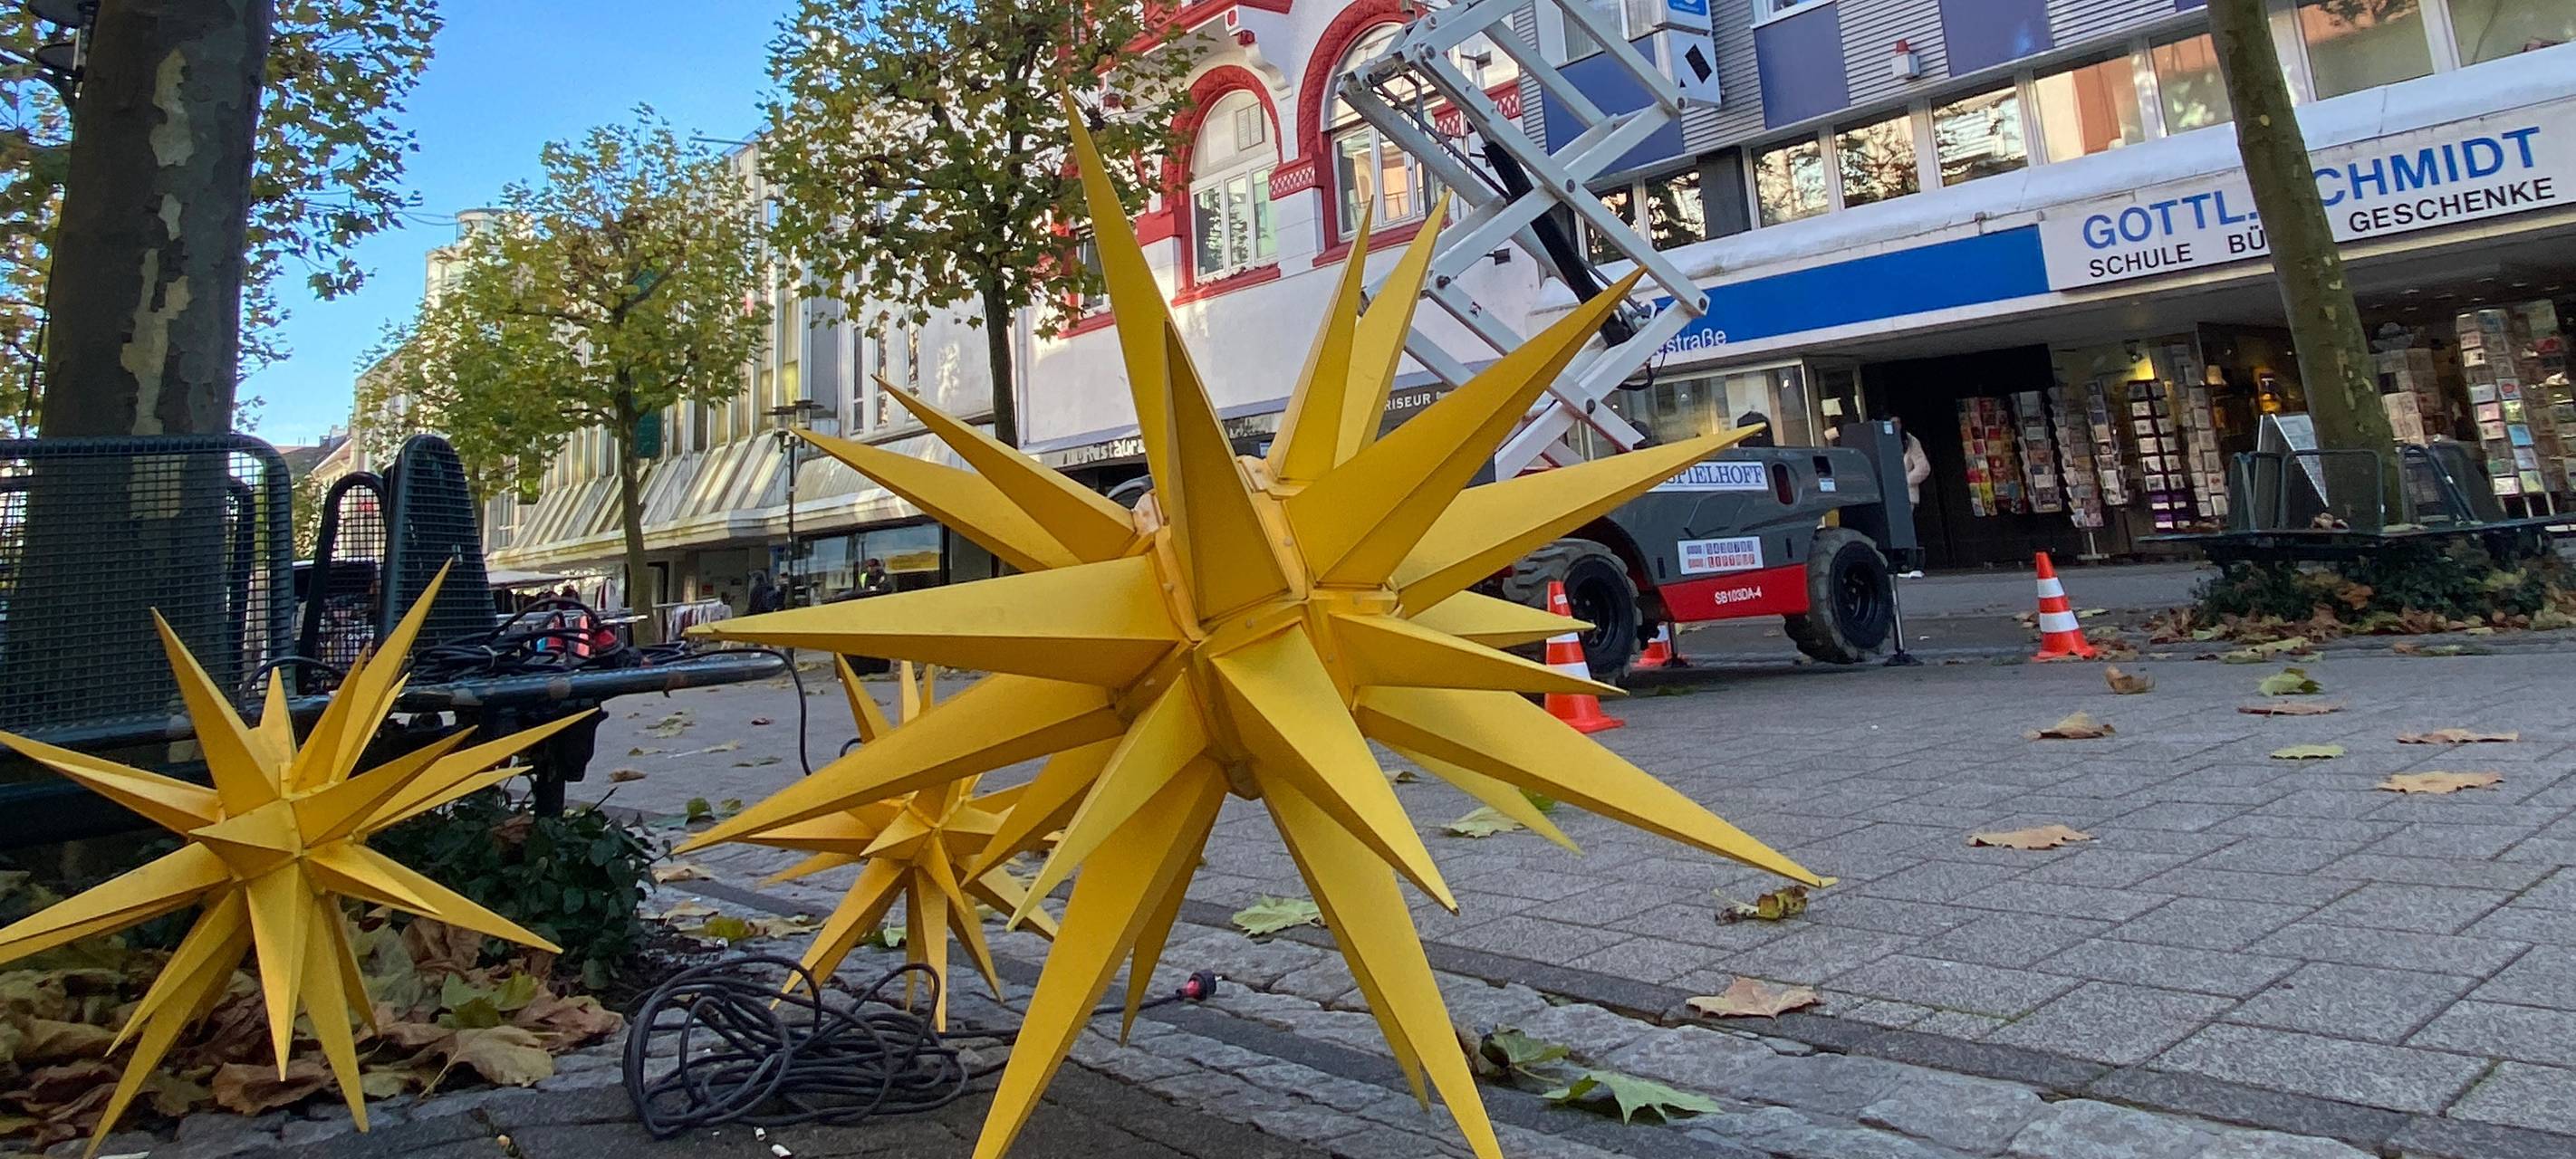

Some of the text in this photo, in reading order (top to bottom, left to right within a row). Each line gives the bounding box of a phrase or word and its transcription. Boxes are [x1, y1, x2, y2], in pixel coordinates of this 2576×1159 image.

[2083, 126, 2541, 250] GOTTL. CHMIDT
[2089, 177, 2556, 278] SCHULE BÜ GESCHENKE
[1384, 393, 1431, 411] RISEUR
